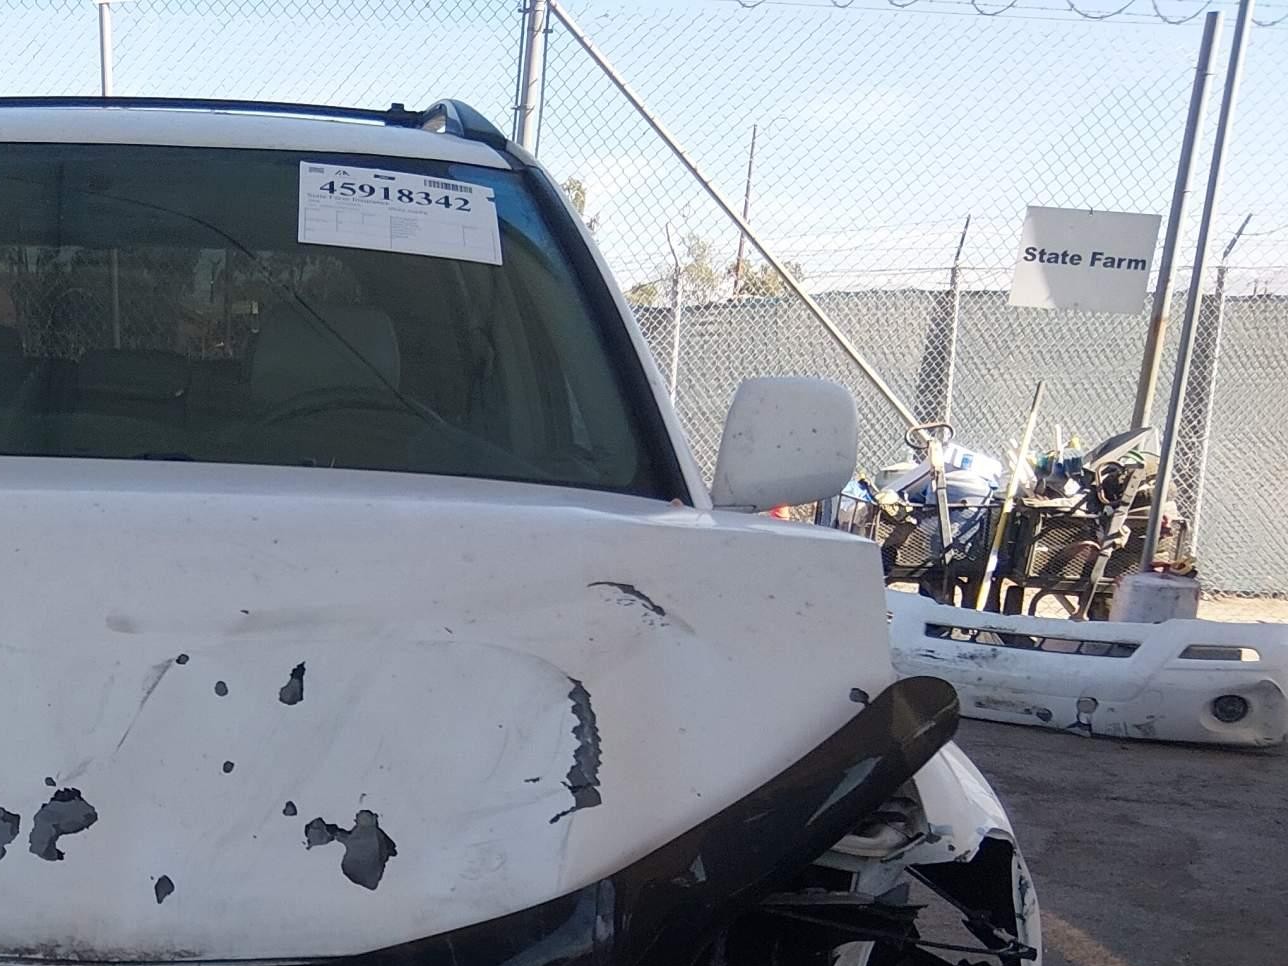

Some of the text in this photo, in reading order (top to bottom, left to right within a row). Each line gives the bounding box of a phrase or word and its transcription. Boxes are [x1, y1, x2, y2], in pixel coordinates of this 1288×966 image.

[319, 180, 472, 212] 45918342
[1023, 246, 1147, 271] State Farm
